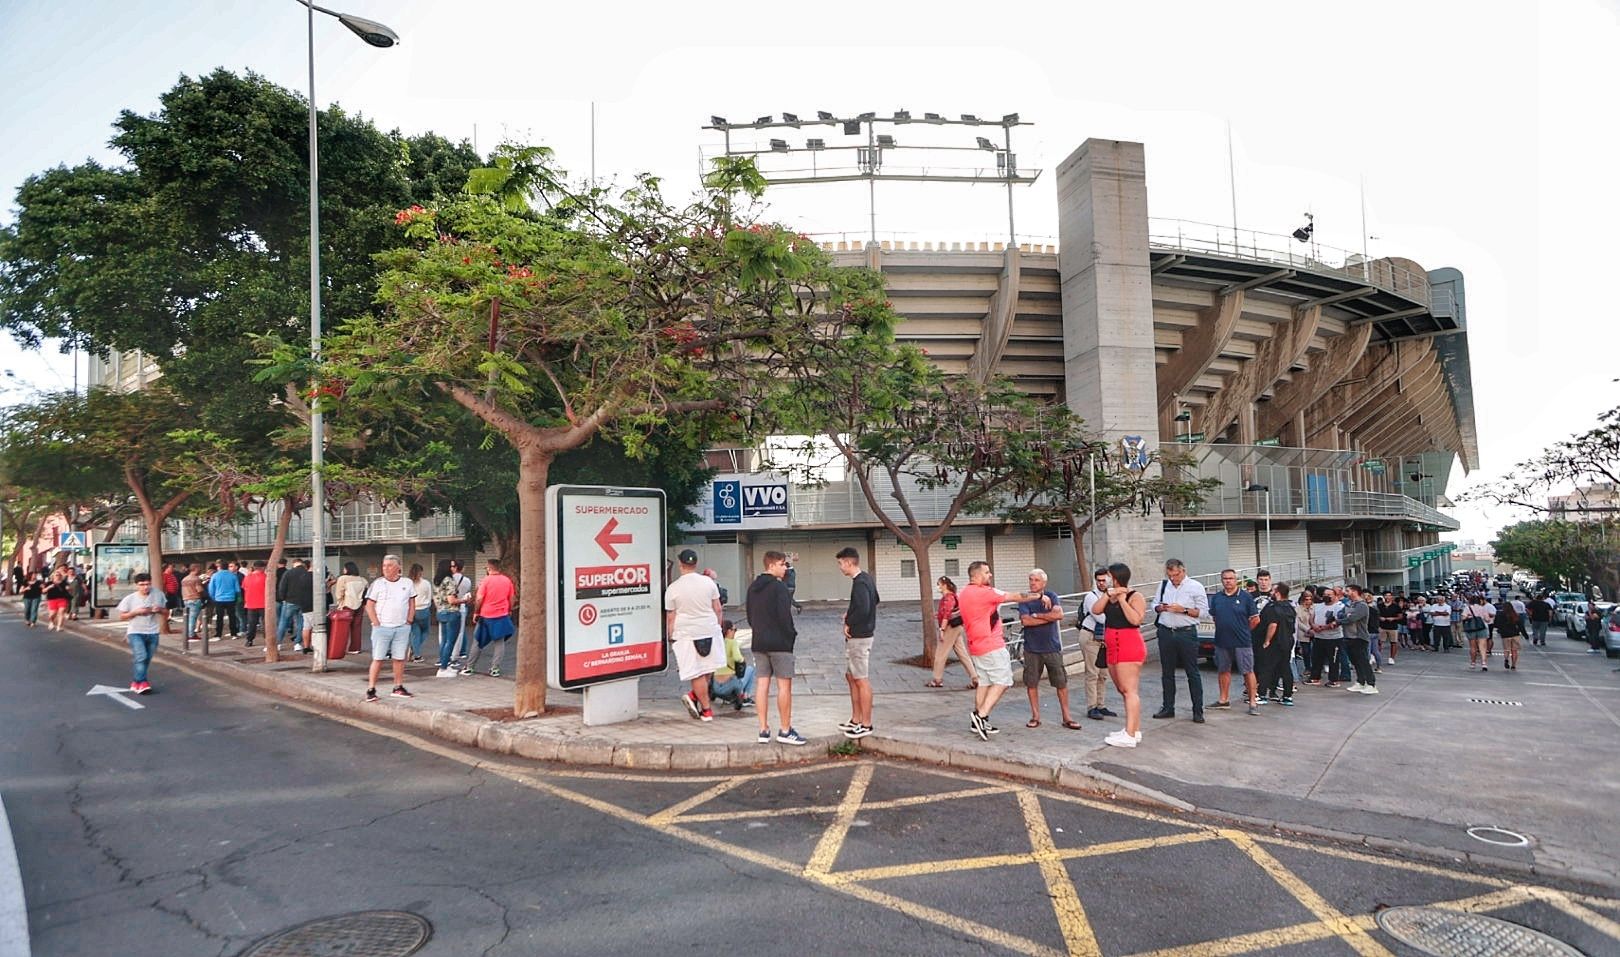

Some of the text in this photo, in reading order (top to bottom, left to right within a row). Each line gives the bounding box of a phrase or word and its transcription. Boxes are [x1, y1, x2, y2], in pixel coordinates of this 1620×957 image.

[743, 486, 786, 506] VVO
[575, 505, 649, 515] SUPERMERCADO
[601, 584, 649, 597] supermercados
[610, 625, 622, 643] P
[609, 649, 630, 657] GRANJA
[591, 656, 625, 667] BERNARDINO
